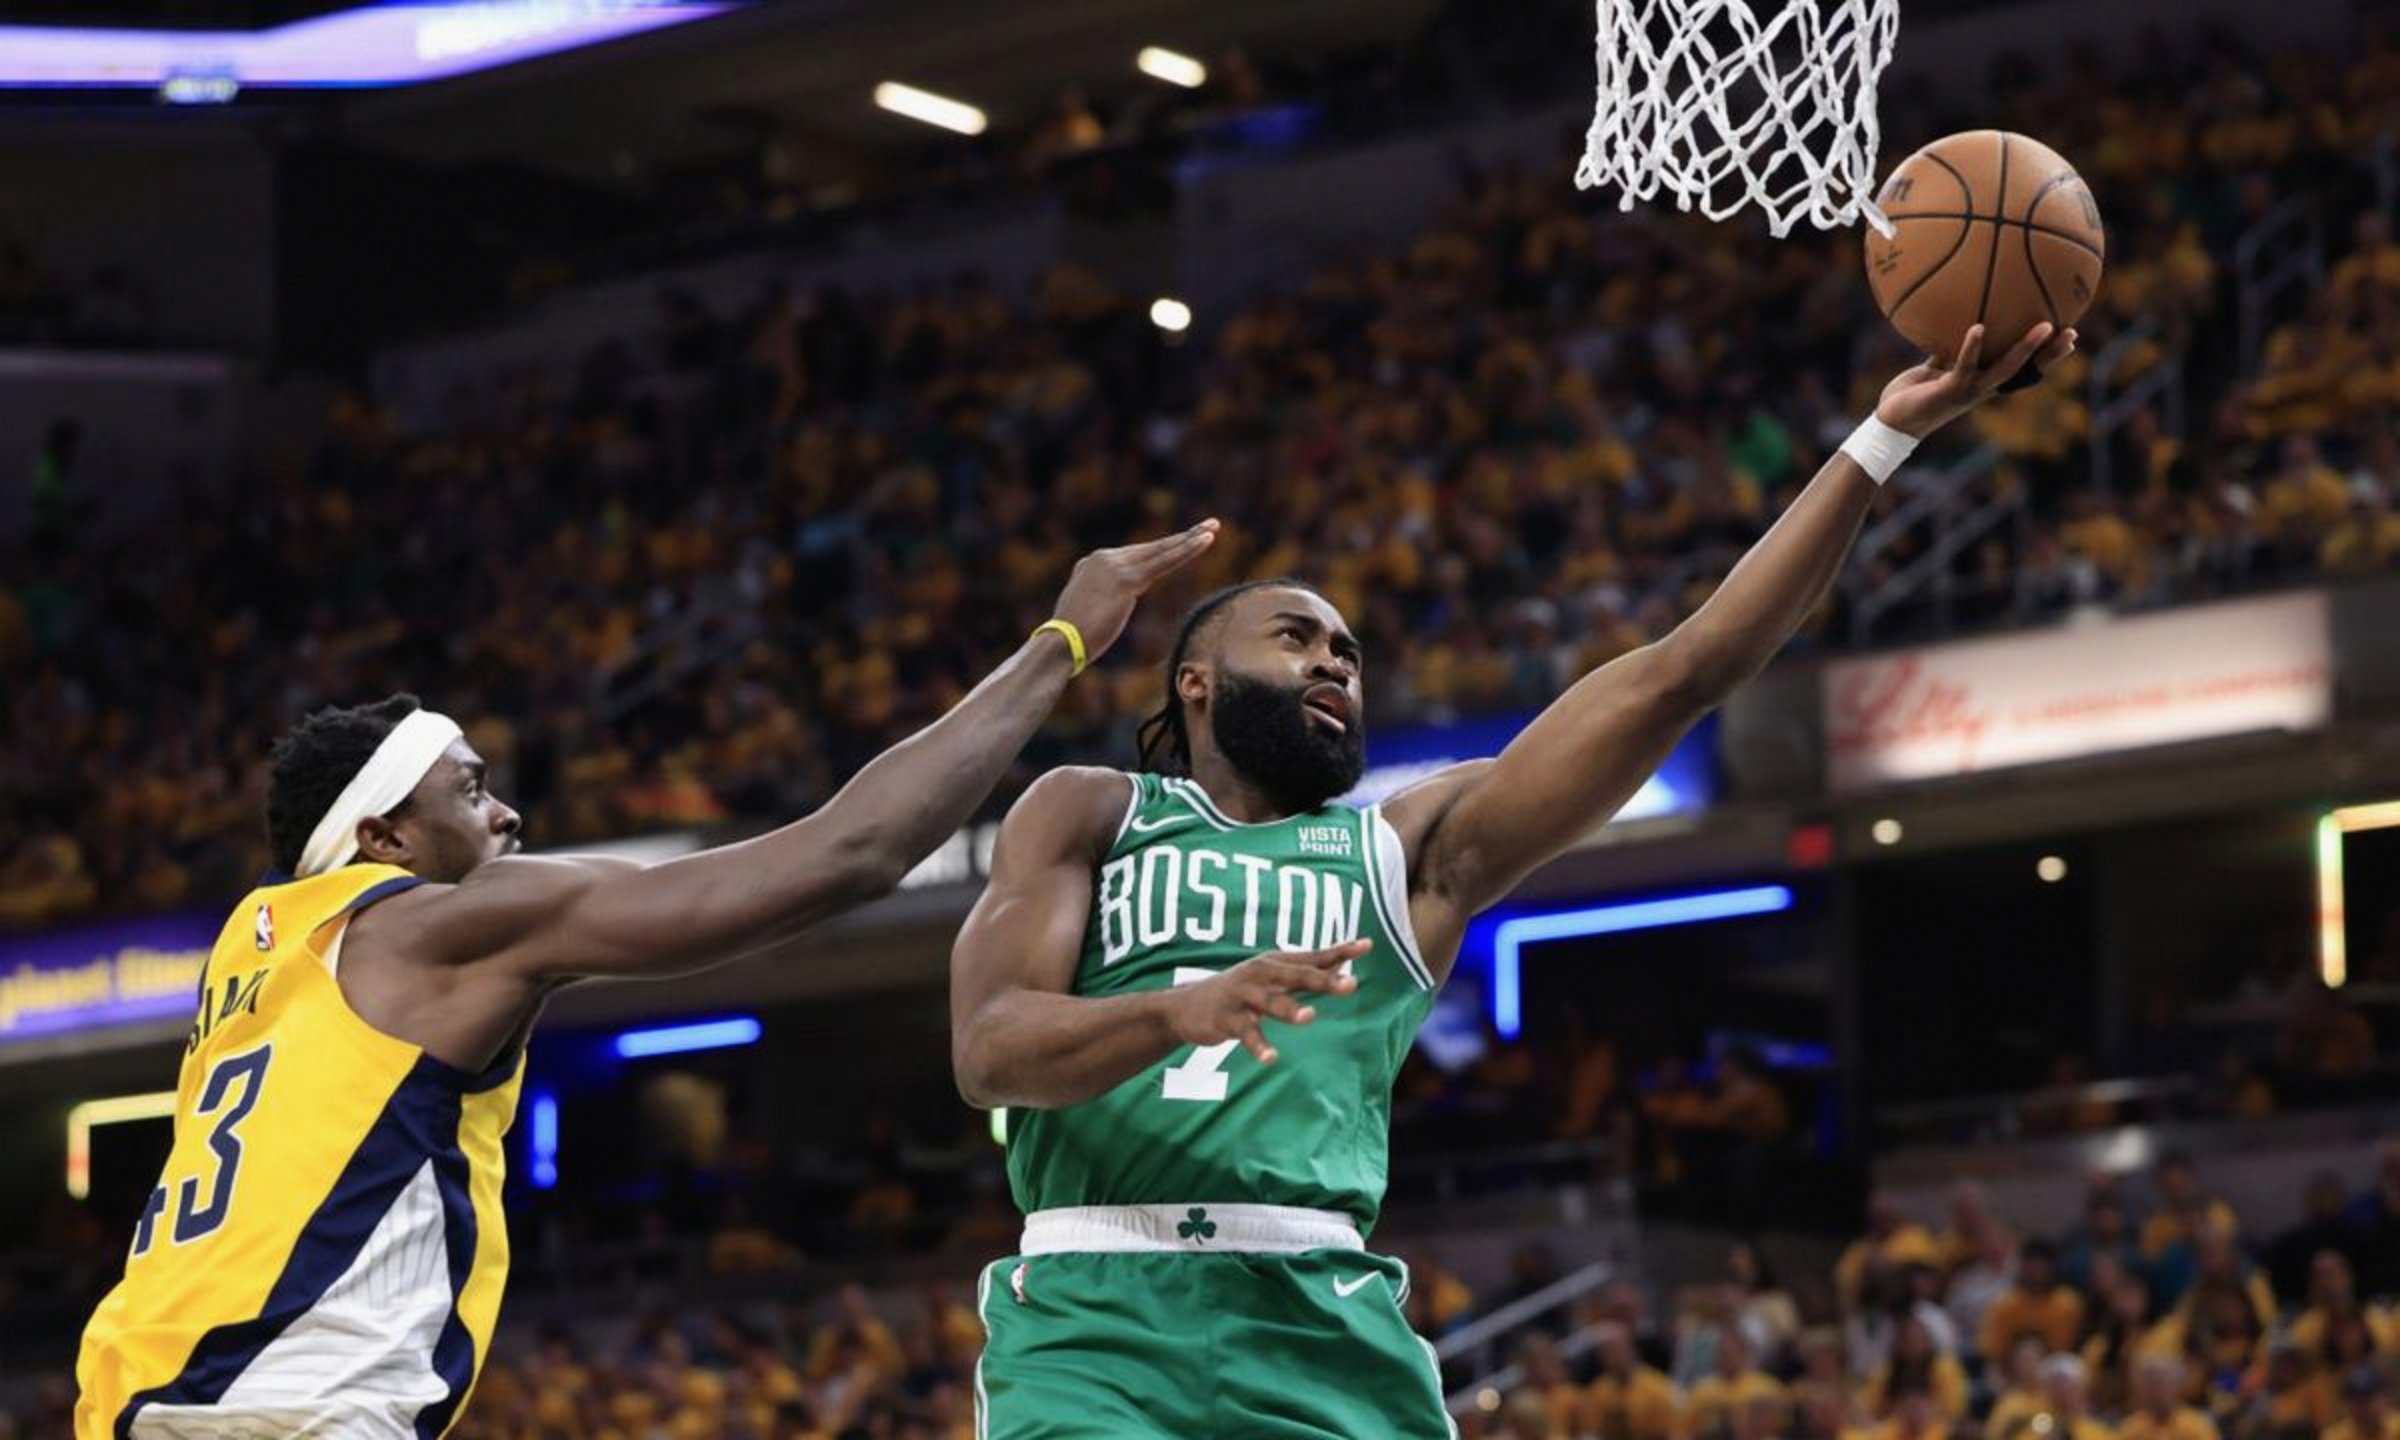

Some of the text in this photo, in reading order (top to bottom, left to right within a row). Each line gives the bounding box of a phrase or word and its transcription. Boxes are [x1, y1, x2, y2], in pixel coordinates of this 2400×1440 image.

[1297, 826, 1351, 842] VISTA
[1299, 842, 1352, 856] PRINT
[1100, 844, 1363, 977] BOSTON
